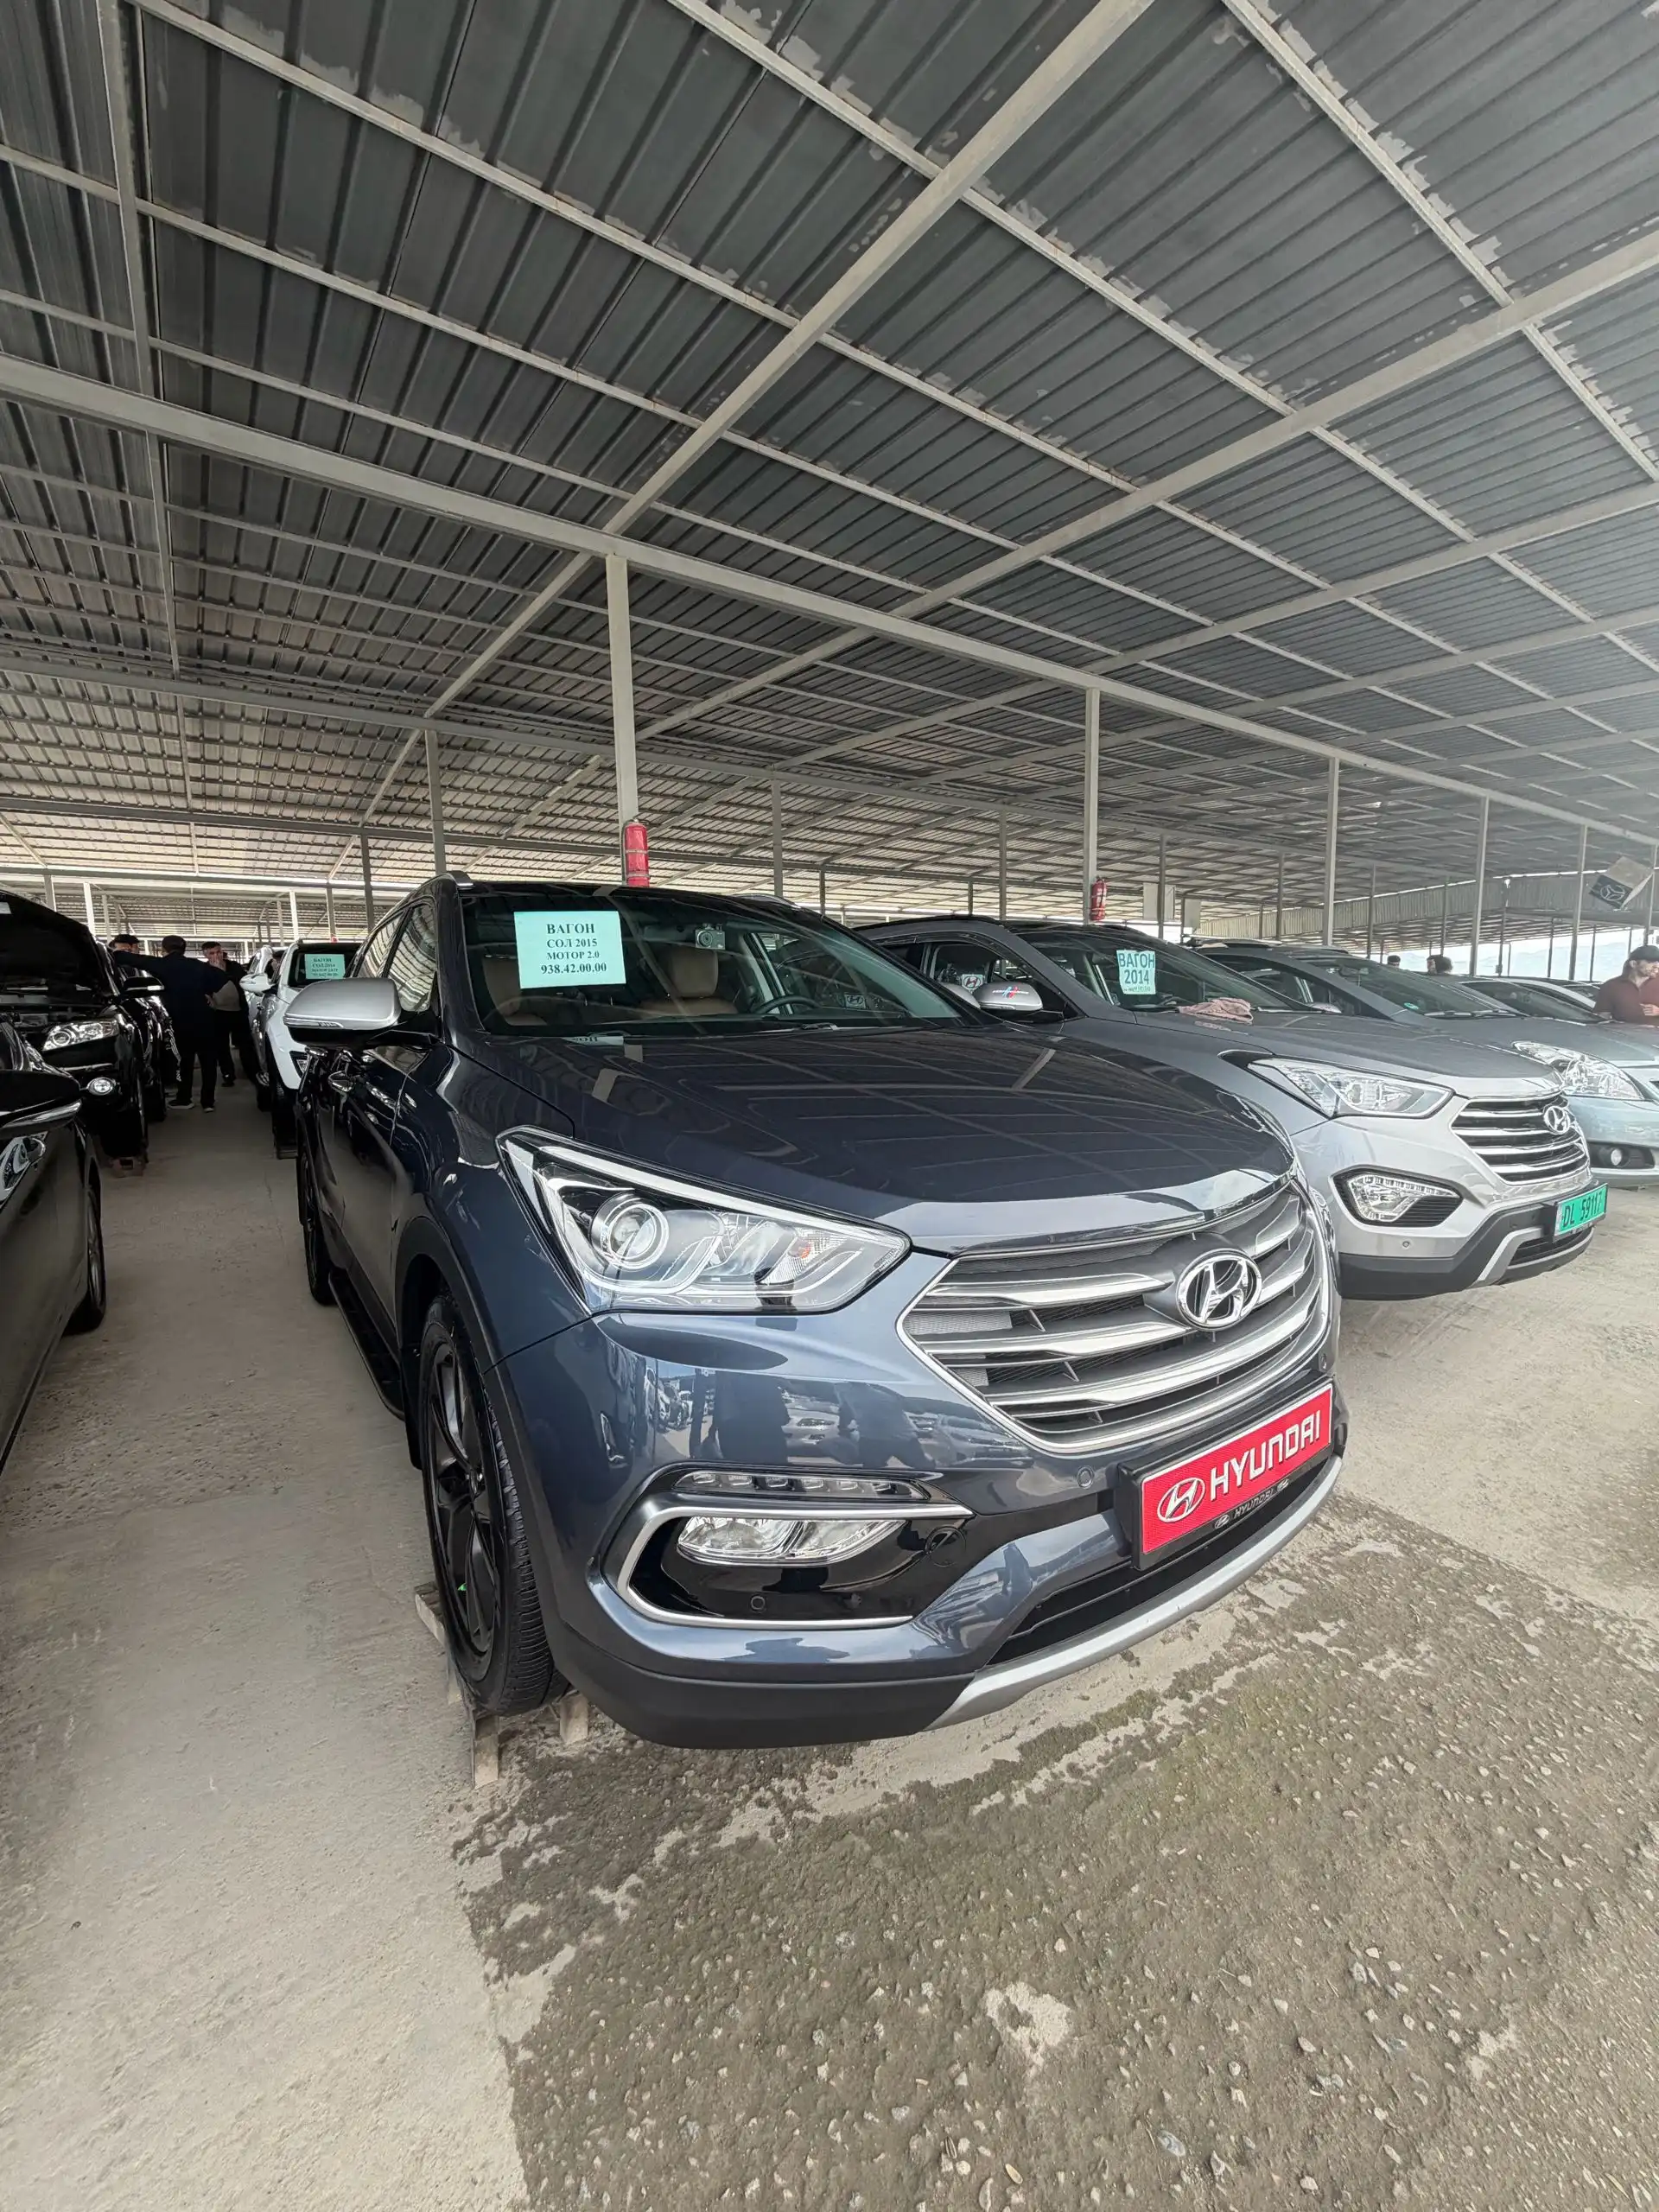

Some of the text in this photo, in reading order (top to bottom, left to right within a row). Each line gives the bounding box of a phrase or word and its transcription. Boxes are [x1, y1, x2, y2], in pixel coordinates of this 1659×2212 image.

[546, 923, 595, 934] ВАГОН
[546, 938, 598, 949] СОЛ 2015
[546, 950, 600, 960] МОТОР 2.0
[1118, 953, 1155, 968] ВАГОН
[541, 962, 607, 974] 938.42.00.00
[1124, 969, 1149, 985] 2014
[1562, 1203, 1575, 1228] DL
[1210, 1409, 1321, 1502] HYUNDAI
[1233, 1488, 1274, 1519] HYUNDAI
